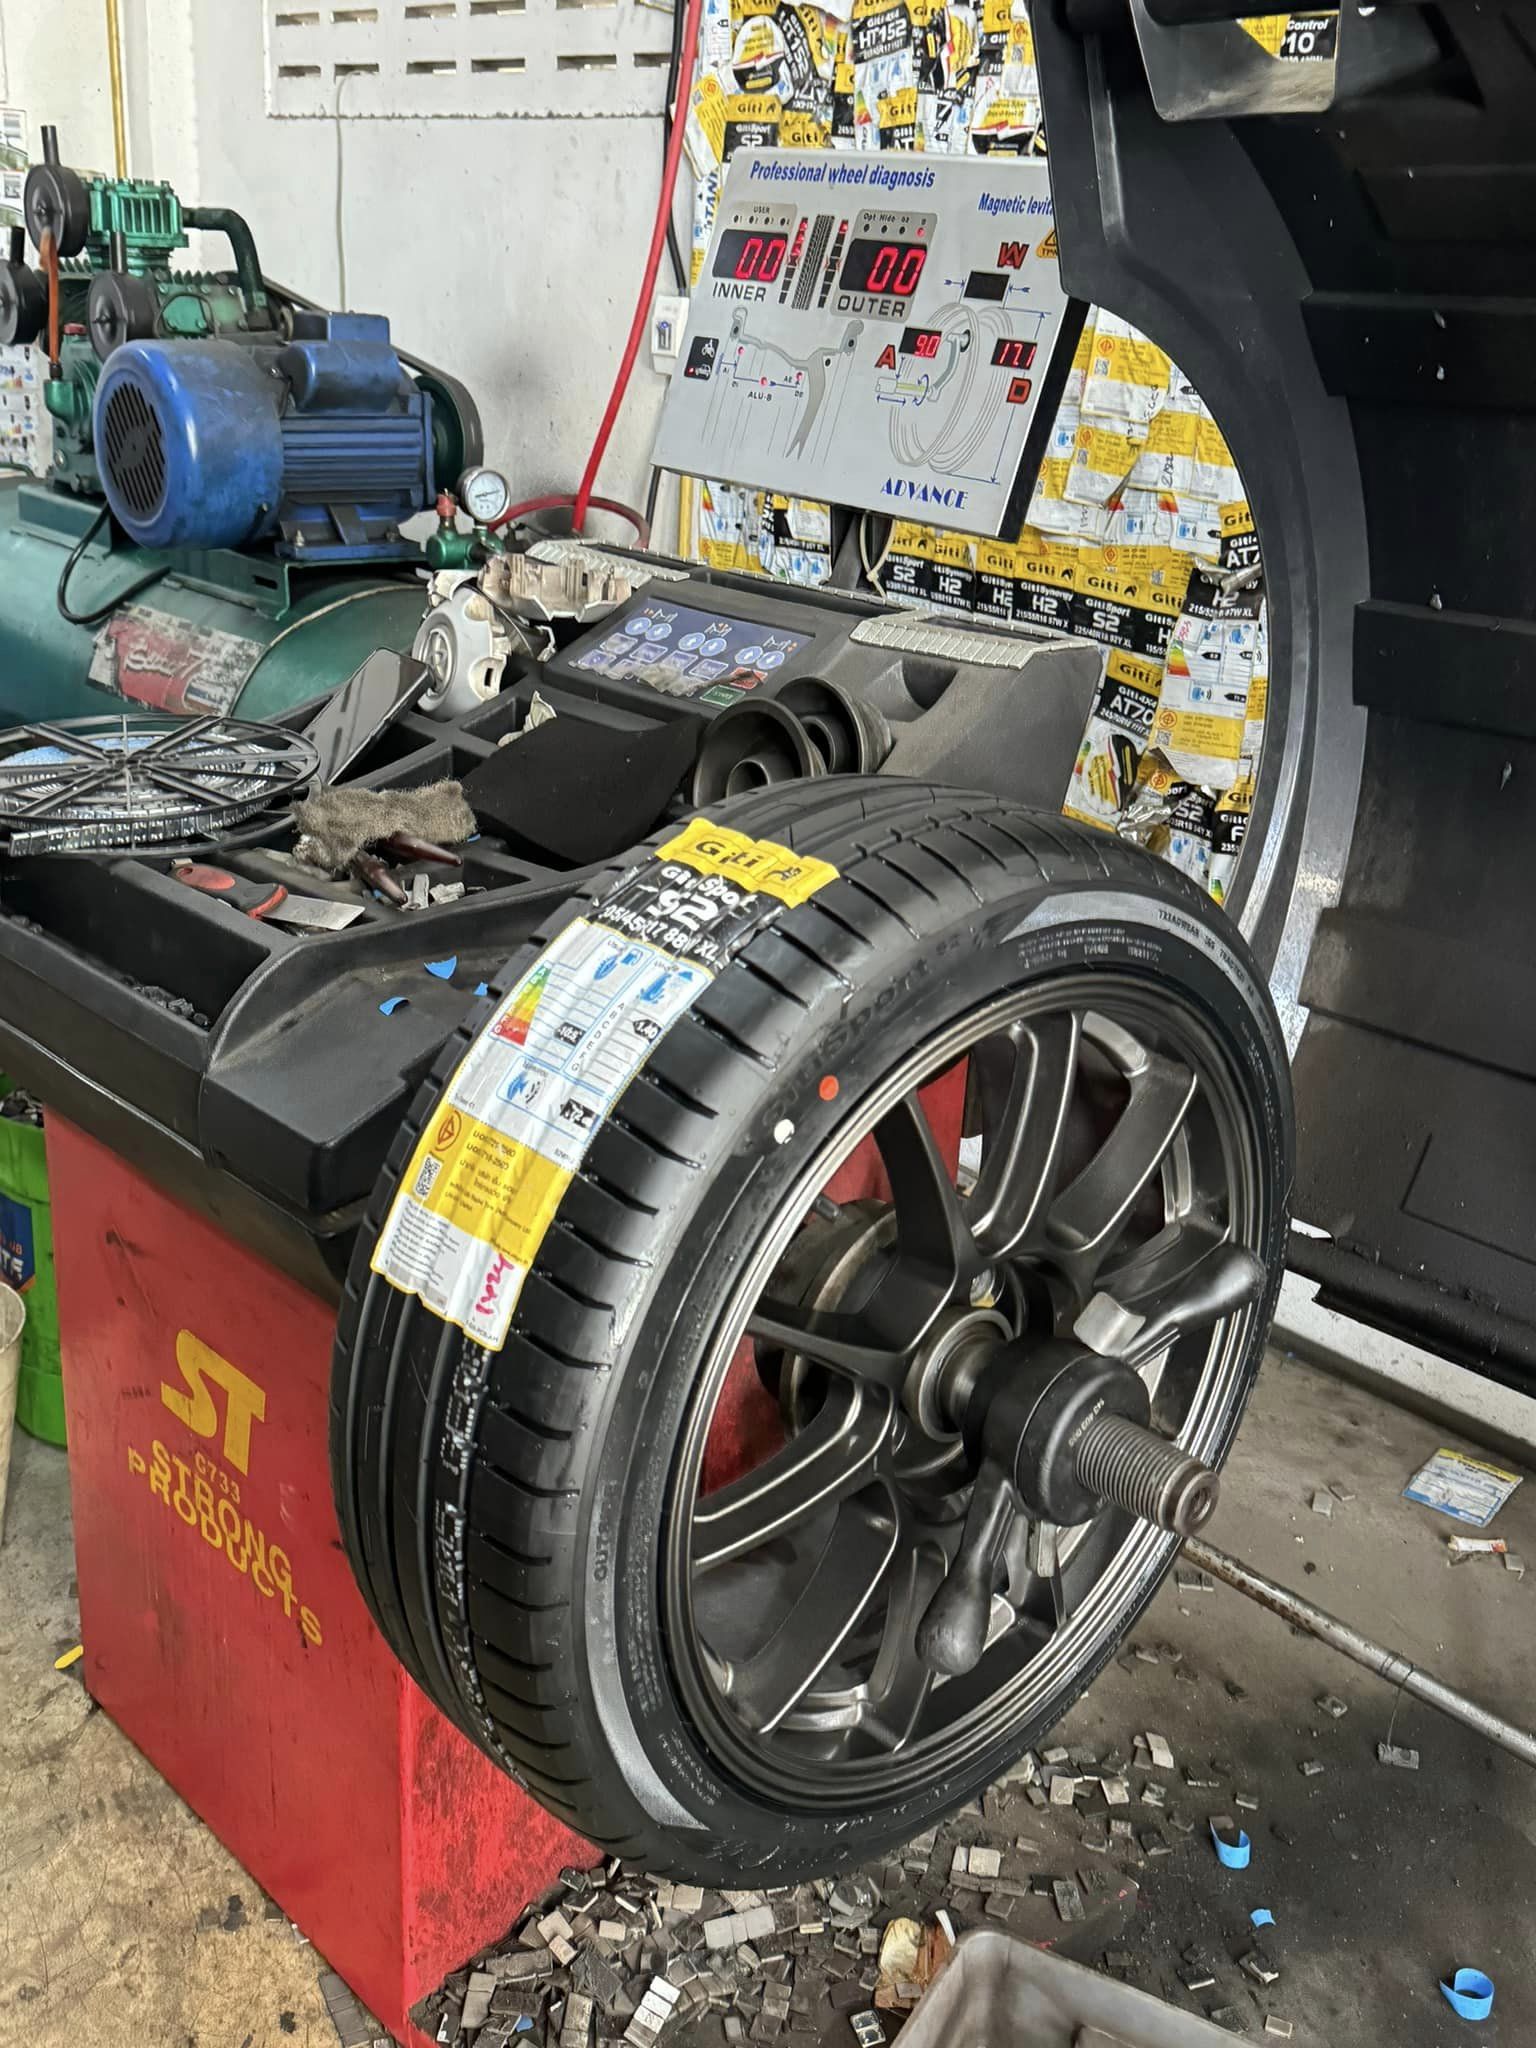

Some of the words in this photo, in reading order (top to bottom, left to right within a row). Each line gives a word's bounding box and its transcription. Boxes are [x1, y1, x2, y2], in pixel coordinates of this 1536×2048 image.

[859, 18, 907, 49] HT152
[1287, 19, 1328, 31] Control
[1281, 32, 1314, 54] 10
[750, 160, 827, 184] Professional
[829, 164, 867, 185] wheel
[869, 165, 936, 190] diagnosis
[753, 206, 770, 214] USER
[978, 192, 1023, 216] Magnetic
[735, 238, 787, 281] 00
[996, 241, 1030, 269] W
[866, 246, 927, 296] 00
[712, 282, 767, 302] INNER
[837, 295, 907, 317] OUTER
[874, 344, 896, 370] A
[1006, 377, 1032, 404] D
[880, 477, 969, 510] ADVANCE
[987, 554, 1013, 570] Giti
[1026, 561, 1055, 577] Giti
[893, 564, 916, 584] S2
[1087, 576, 1118, 593] Giti
[939, 575, 962, 596] H2
[1032, 593, 1058, 615] H2
[1085, 598, 1131, 617] GitiSport
[1152, 592, 1182, 608] Giti
[1092, 611, 1120, 633] S2
[1243, 608, 1254, 617] XL
[1120, 663, 1150, 684] Giti
[1110, 694, 1155, 726] AT70
[695, 840, 765, 868] Giti
[161, 1330, 266, 1476] ST
